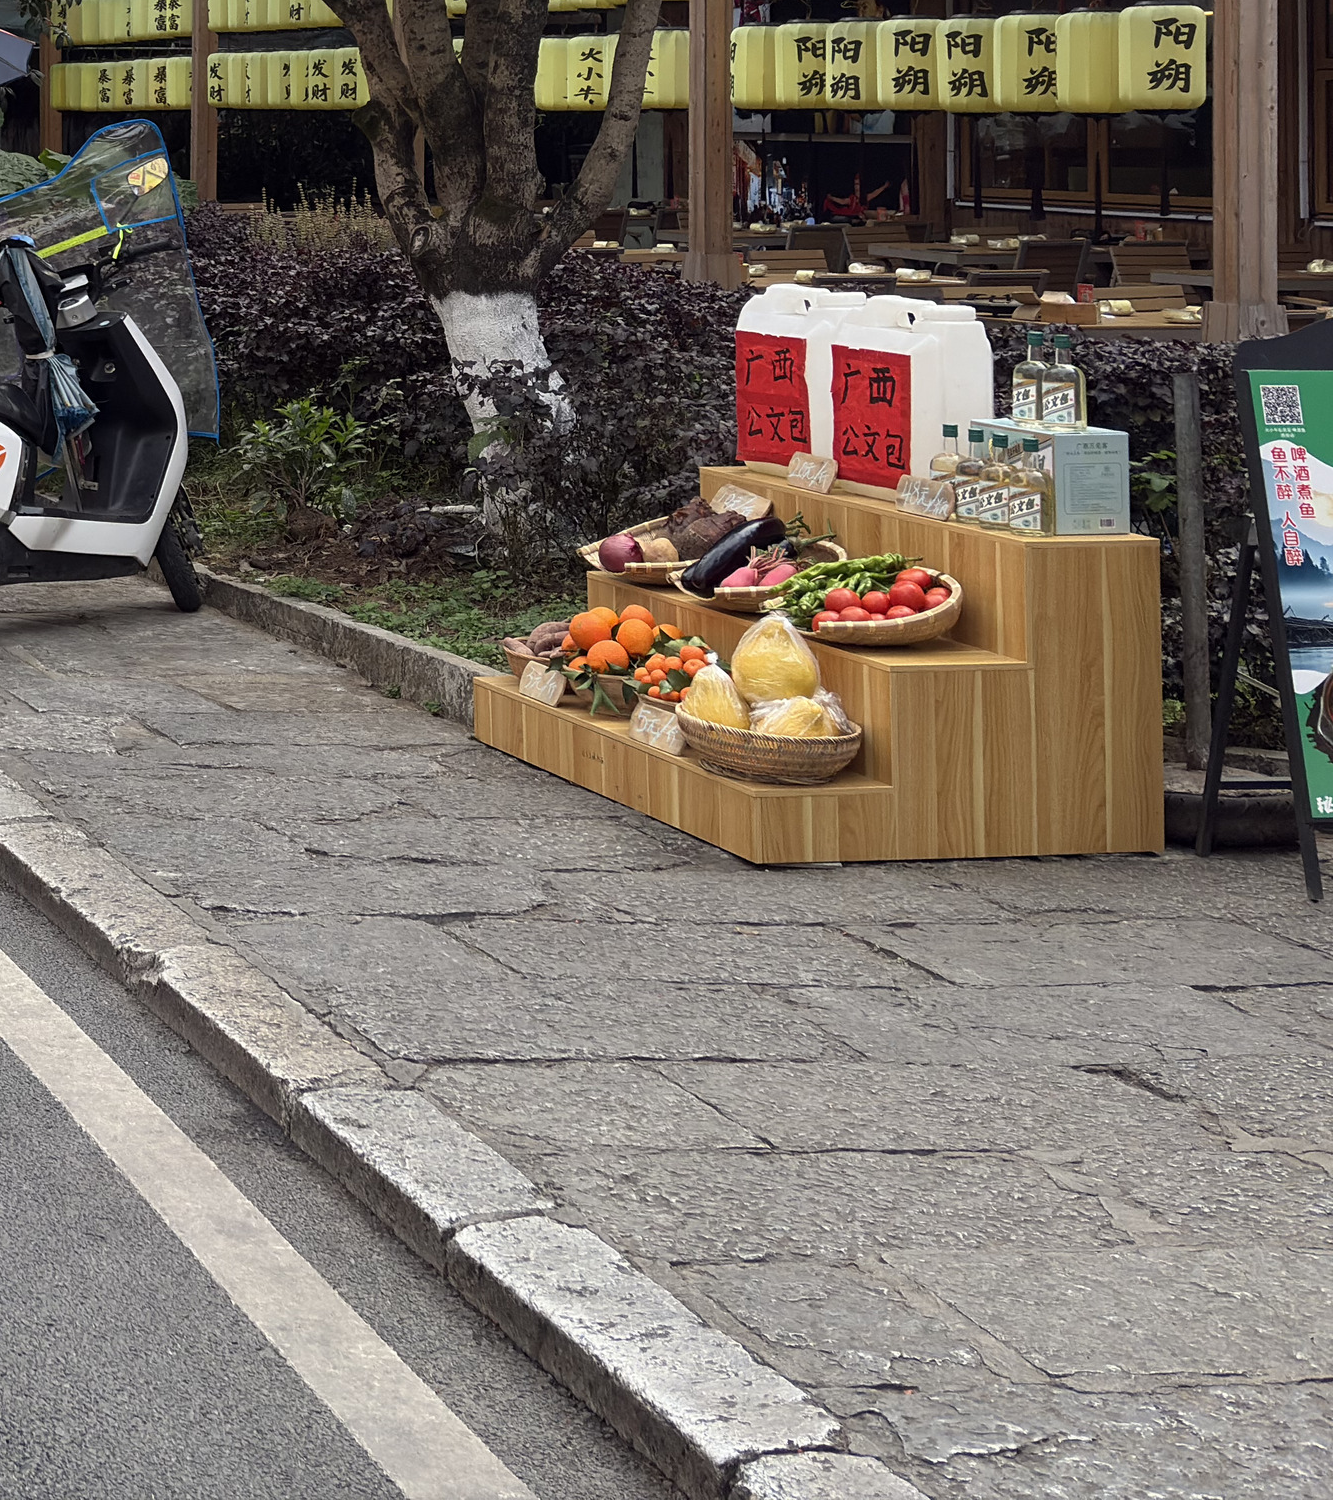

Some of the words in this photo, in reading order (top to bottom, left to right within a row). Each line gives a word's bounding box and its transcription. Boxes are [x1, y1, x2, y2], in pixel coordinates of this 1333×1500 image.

[575, 47, 604, 104] 火小牛
[796, 35, 827, 97] 阳朔
[830, 37, 863, 101] 阳朔
[892, 28, 931, 96] 阳朔
[946, 30, 988, 98] 阳朔
[1147, 17, 1197, 93] 阳朔
[97, 67, 113, 104] 暴富
[121, 65, 136, 106] 暴富
[153, 65, 167, 105] 暴富
[209, 62, 225, 103] 发财
[311, 58, 331, 103] 发财
[339, 57, 358, 102] 发财
[745, 348, 795, 386] 广西
[841, 363, 896, 407] 广西
[747, 405, 808, 444] 公文包
[1044, 393, 1069, 411] 公文包
[843, 424, 906, 470] 公文包
[1290, 446, 1316, 519] 啤酒煮鱼
[1270, 446, 1294, 500] 鱼不醉
[1282, 510, 1304, 566] 人自醉
